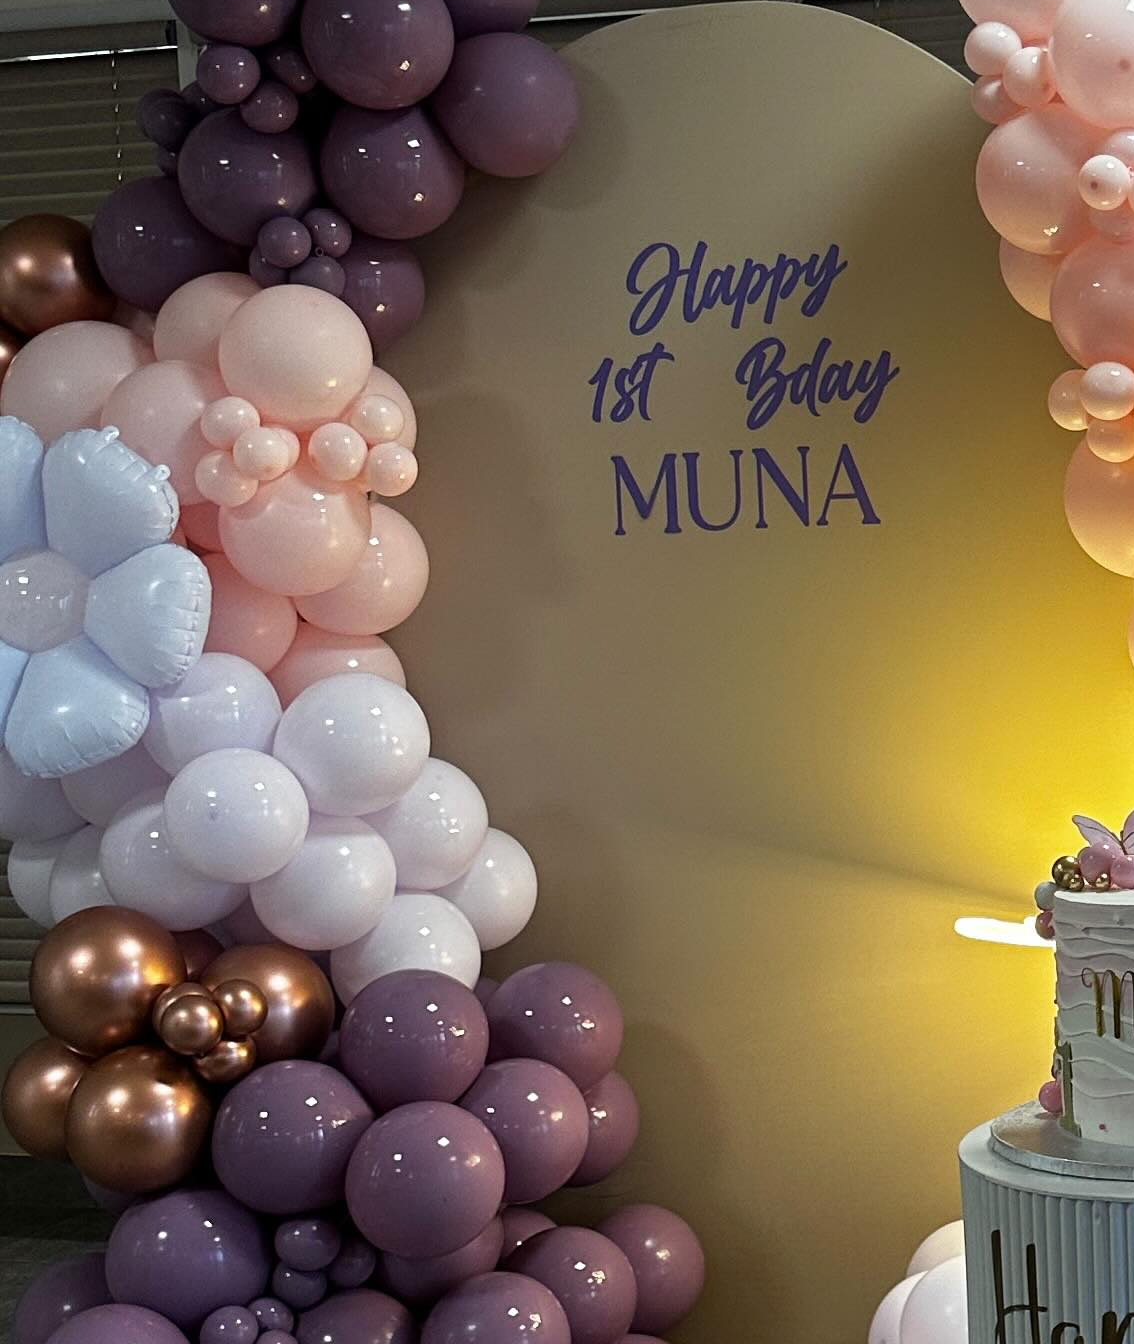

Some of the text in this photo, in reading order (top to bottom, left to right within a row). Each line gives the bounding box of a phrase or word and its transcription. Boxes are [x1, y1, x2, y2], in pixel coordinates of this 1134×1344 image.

[626, 240, 848, 336] Happy
[587, 337, 900, 431] 1st Bday
[610, 443, 881, 536] MUNA
